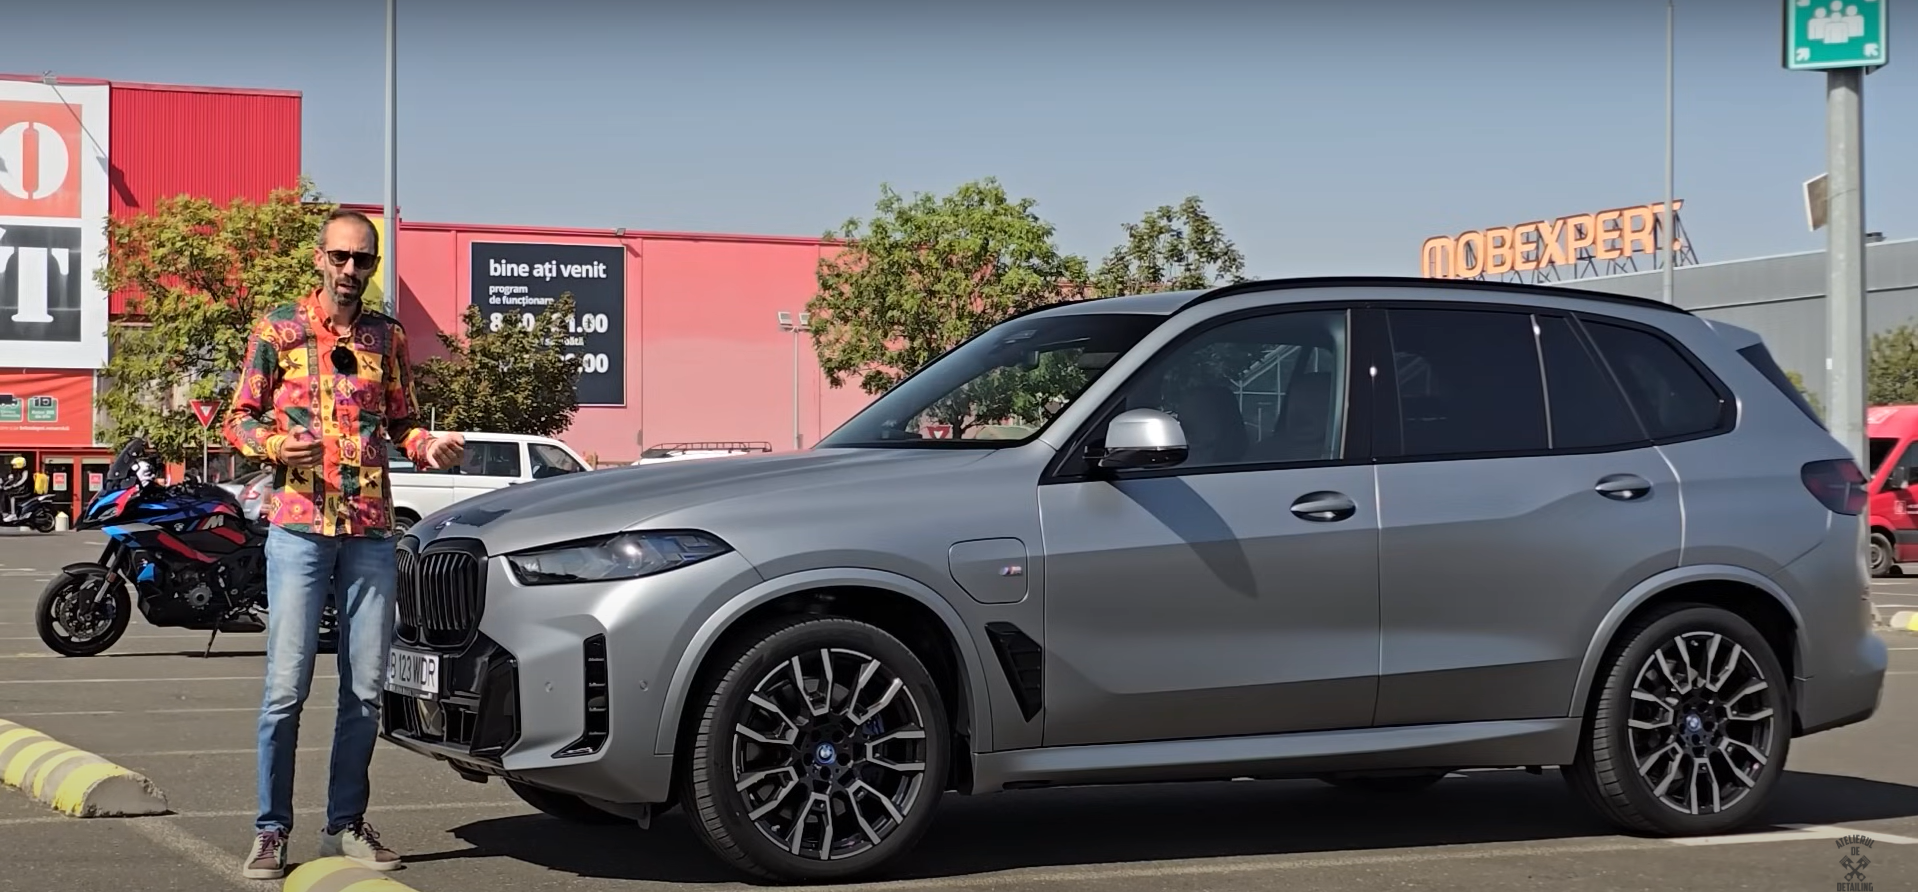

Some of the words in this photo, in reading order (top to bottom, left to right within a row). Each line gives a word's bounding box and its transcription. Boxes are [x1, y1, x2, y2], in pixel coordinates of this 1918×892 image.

[489, 258, 530, 277] bine
[532, 260, 557, 282] ați
[560, 260, 607, 278] venit
[488, 285, 529, 296] program
[488, 294, 501, 305] de
[391, 652, 397, 678] B
[399, 653, 411, 681] 123
